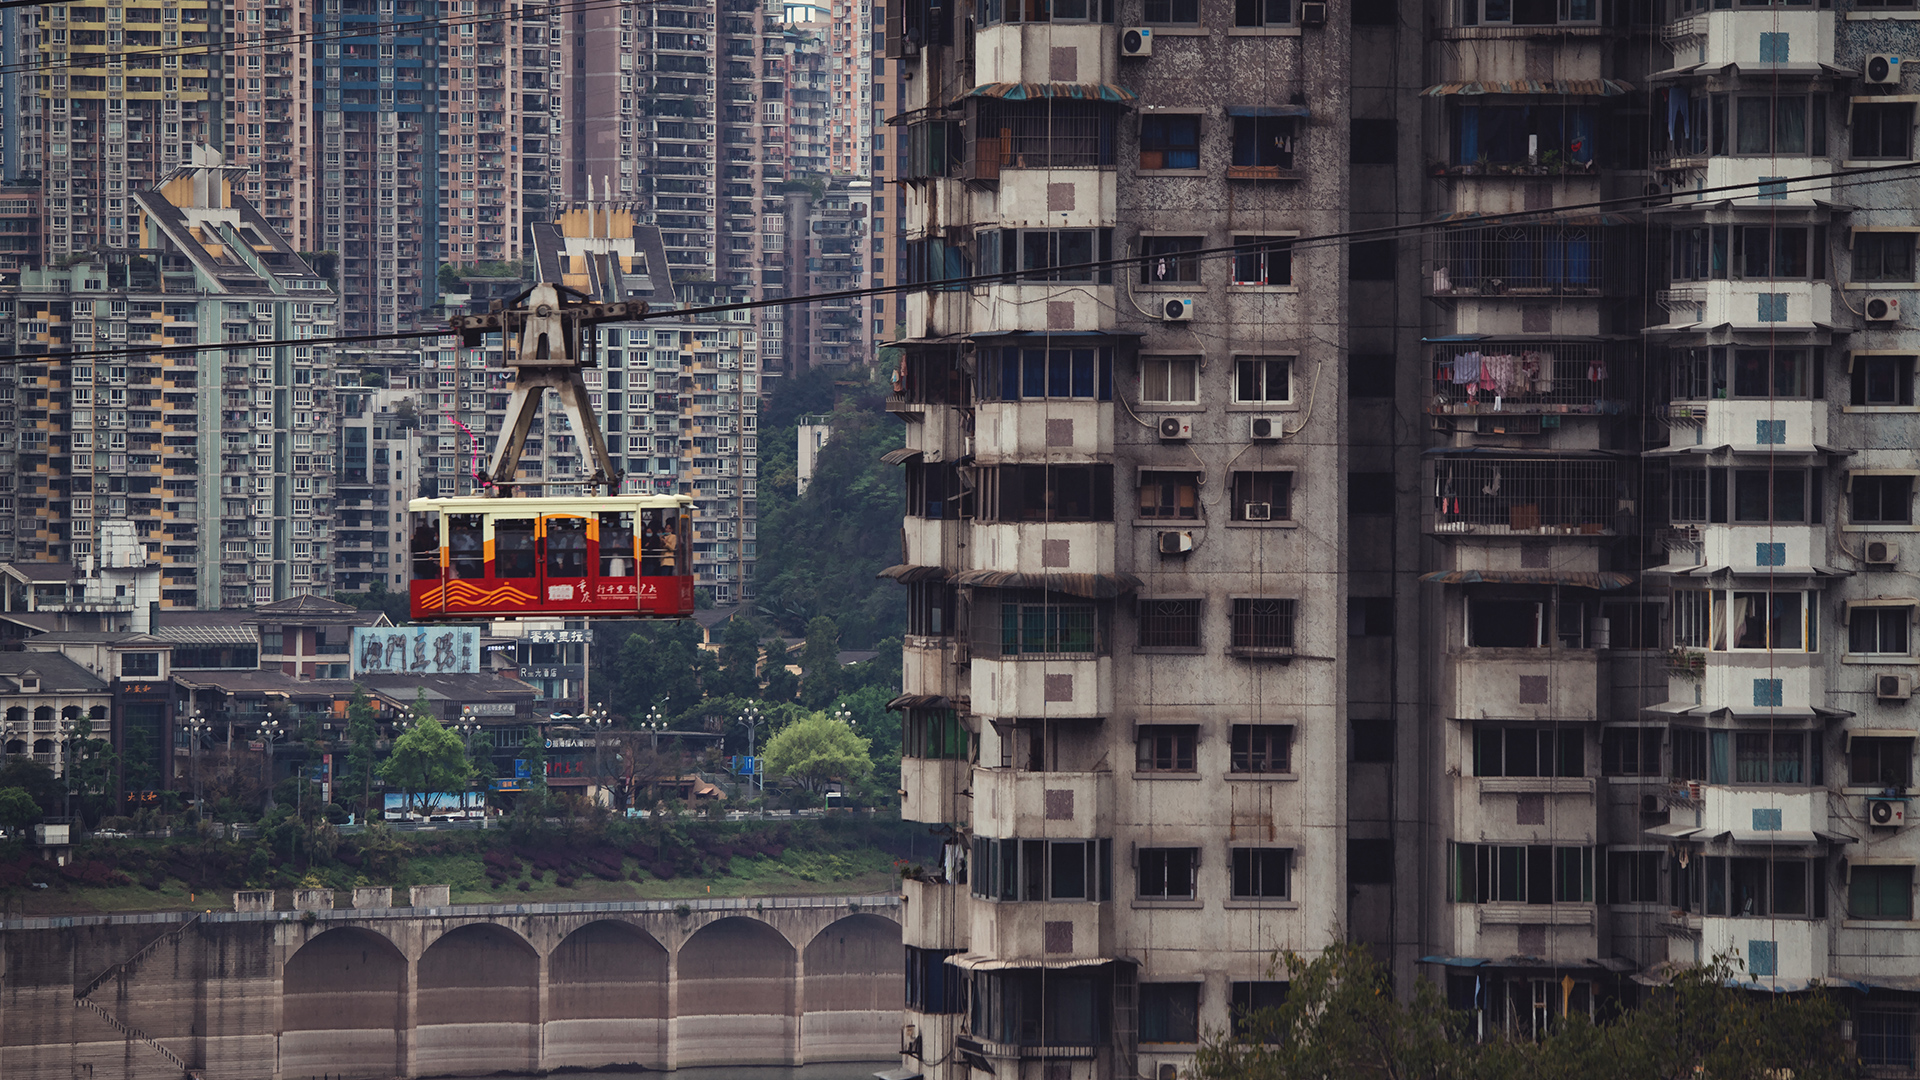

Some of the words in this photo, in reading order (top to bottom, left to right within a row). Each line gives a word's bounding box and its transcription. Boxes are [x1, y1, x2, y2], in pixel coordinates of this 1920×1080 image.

[576, 578, 592, 603] 重庆
[530, 630, 584, 643] 香格里拉
